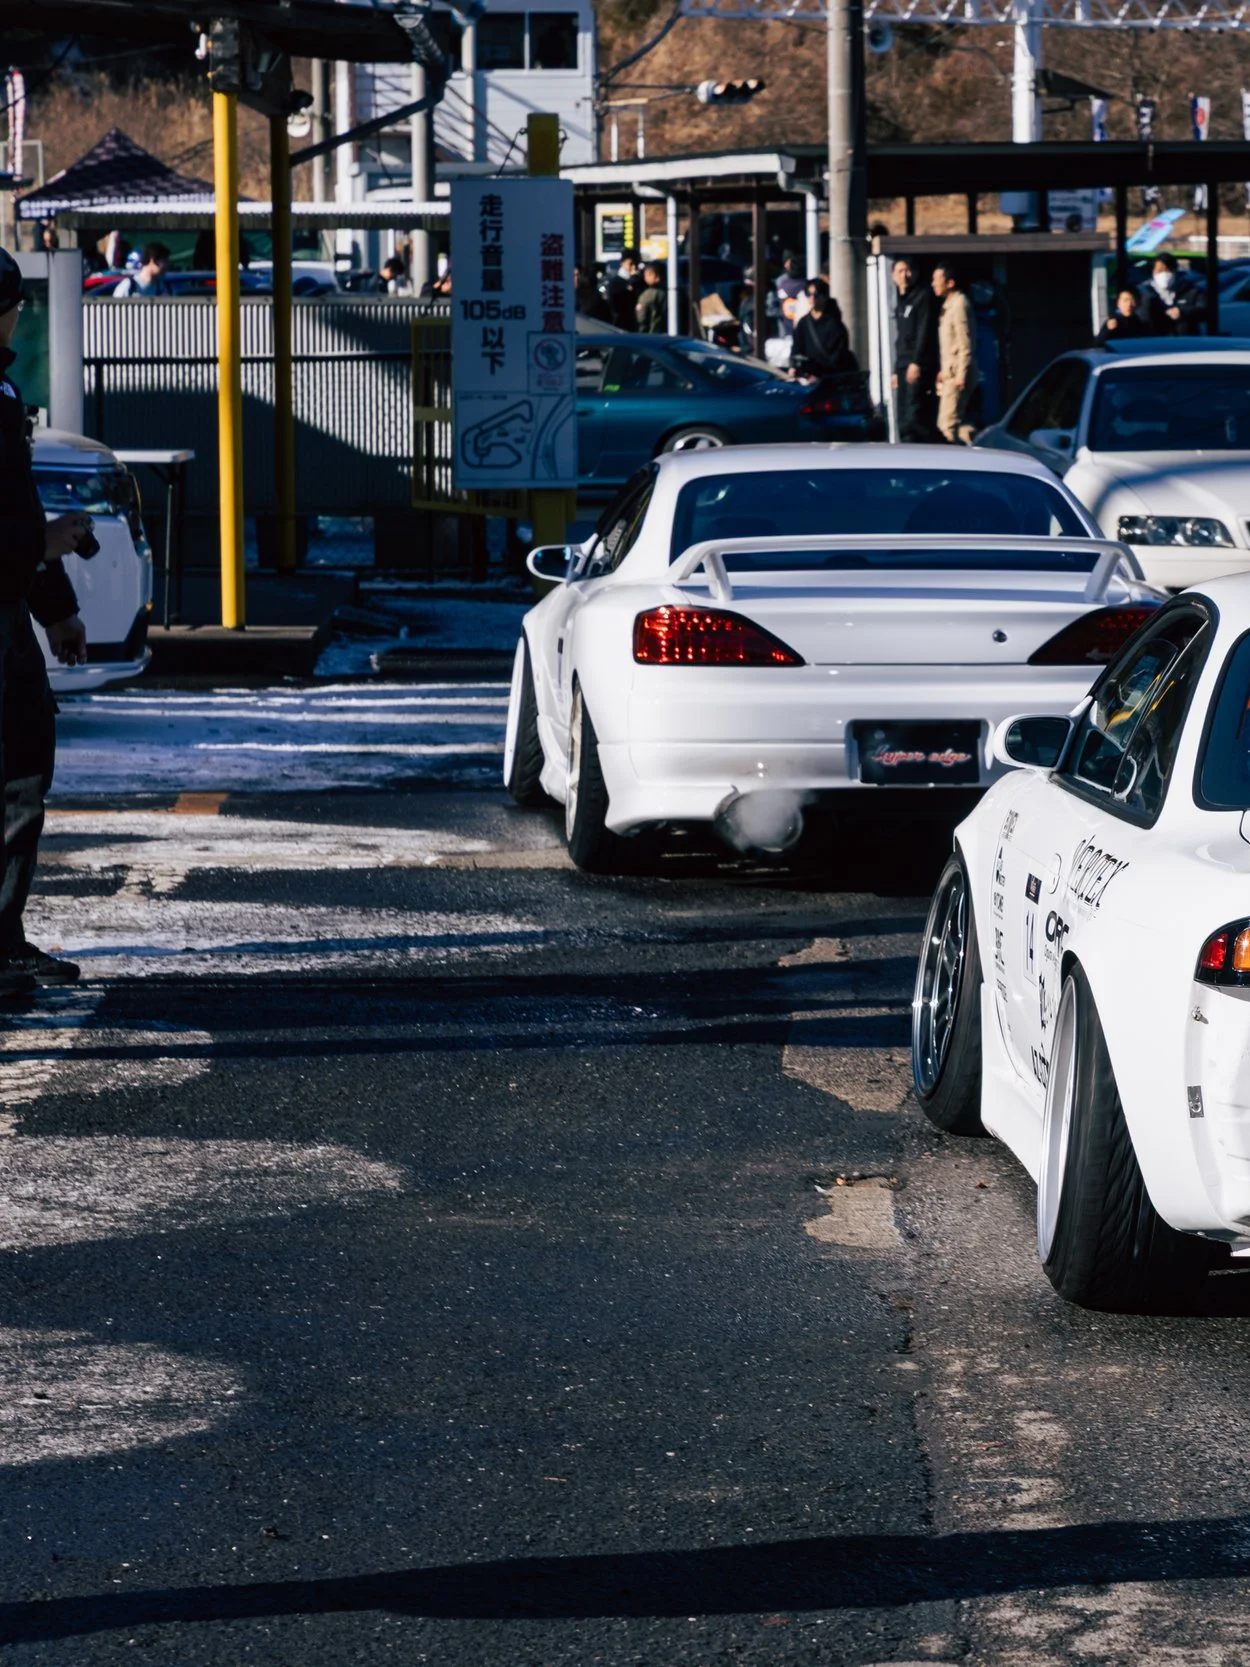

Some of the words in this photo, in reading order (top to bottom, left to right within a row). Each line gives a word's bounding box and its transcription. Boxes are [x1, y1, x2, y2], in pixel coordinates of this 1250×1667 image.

[479, 193, 504, 292] 走行音量
[460, 299, 526, 321] 105dB
[540, 233, 565, 332] 盗難注意
[480, 326, 505, 376] 以下
